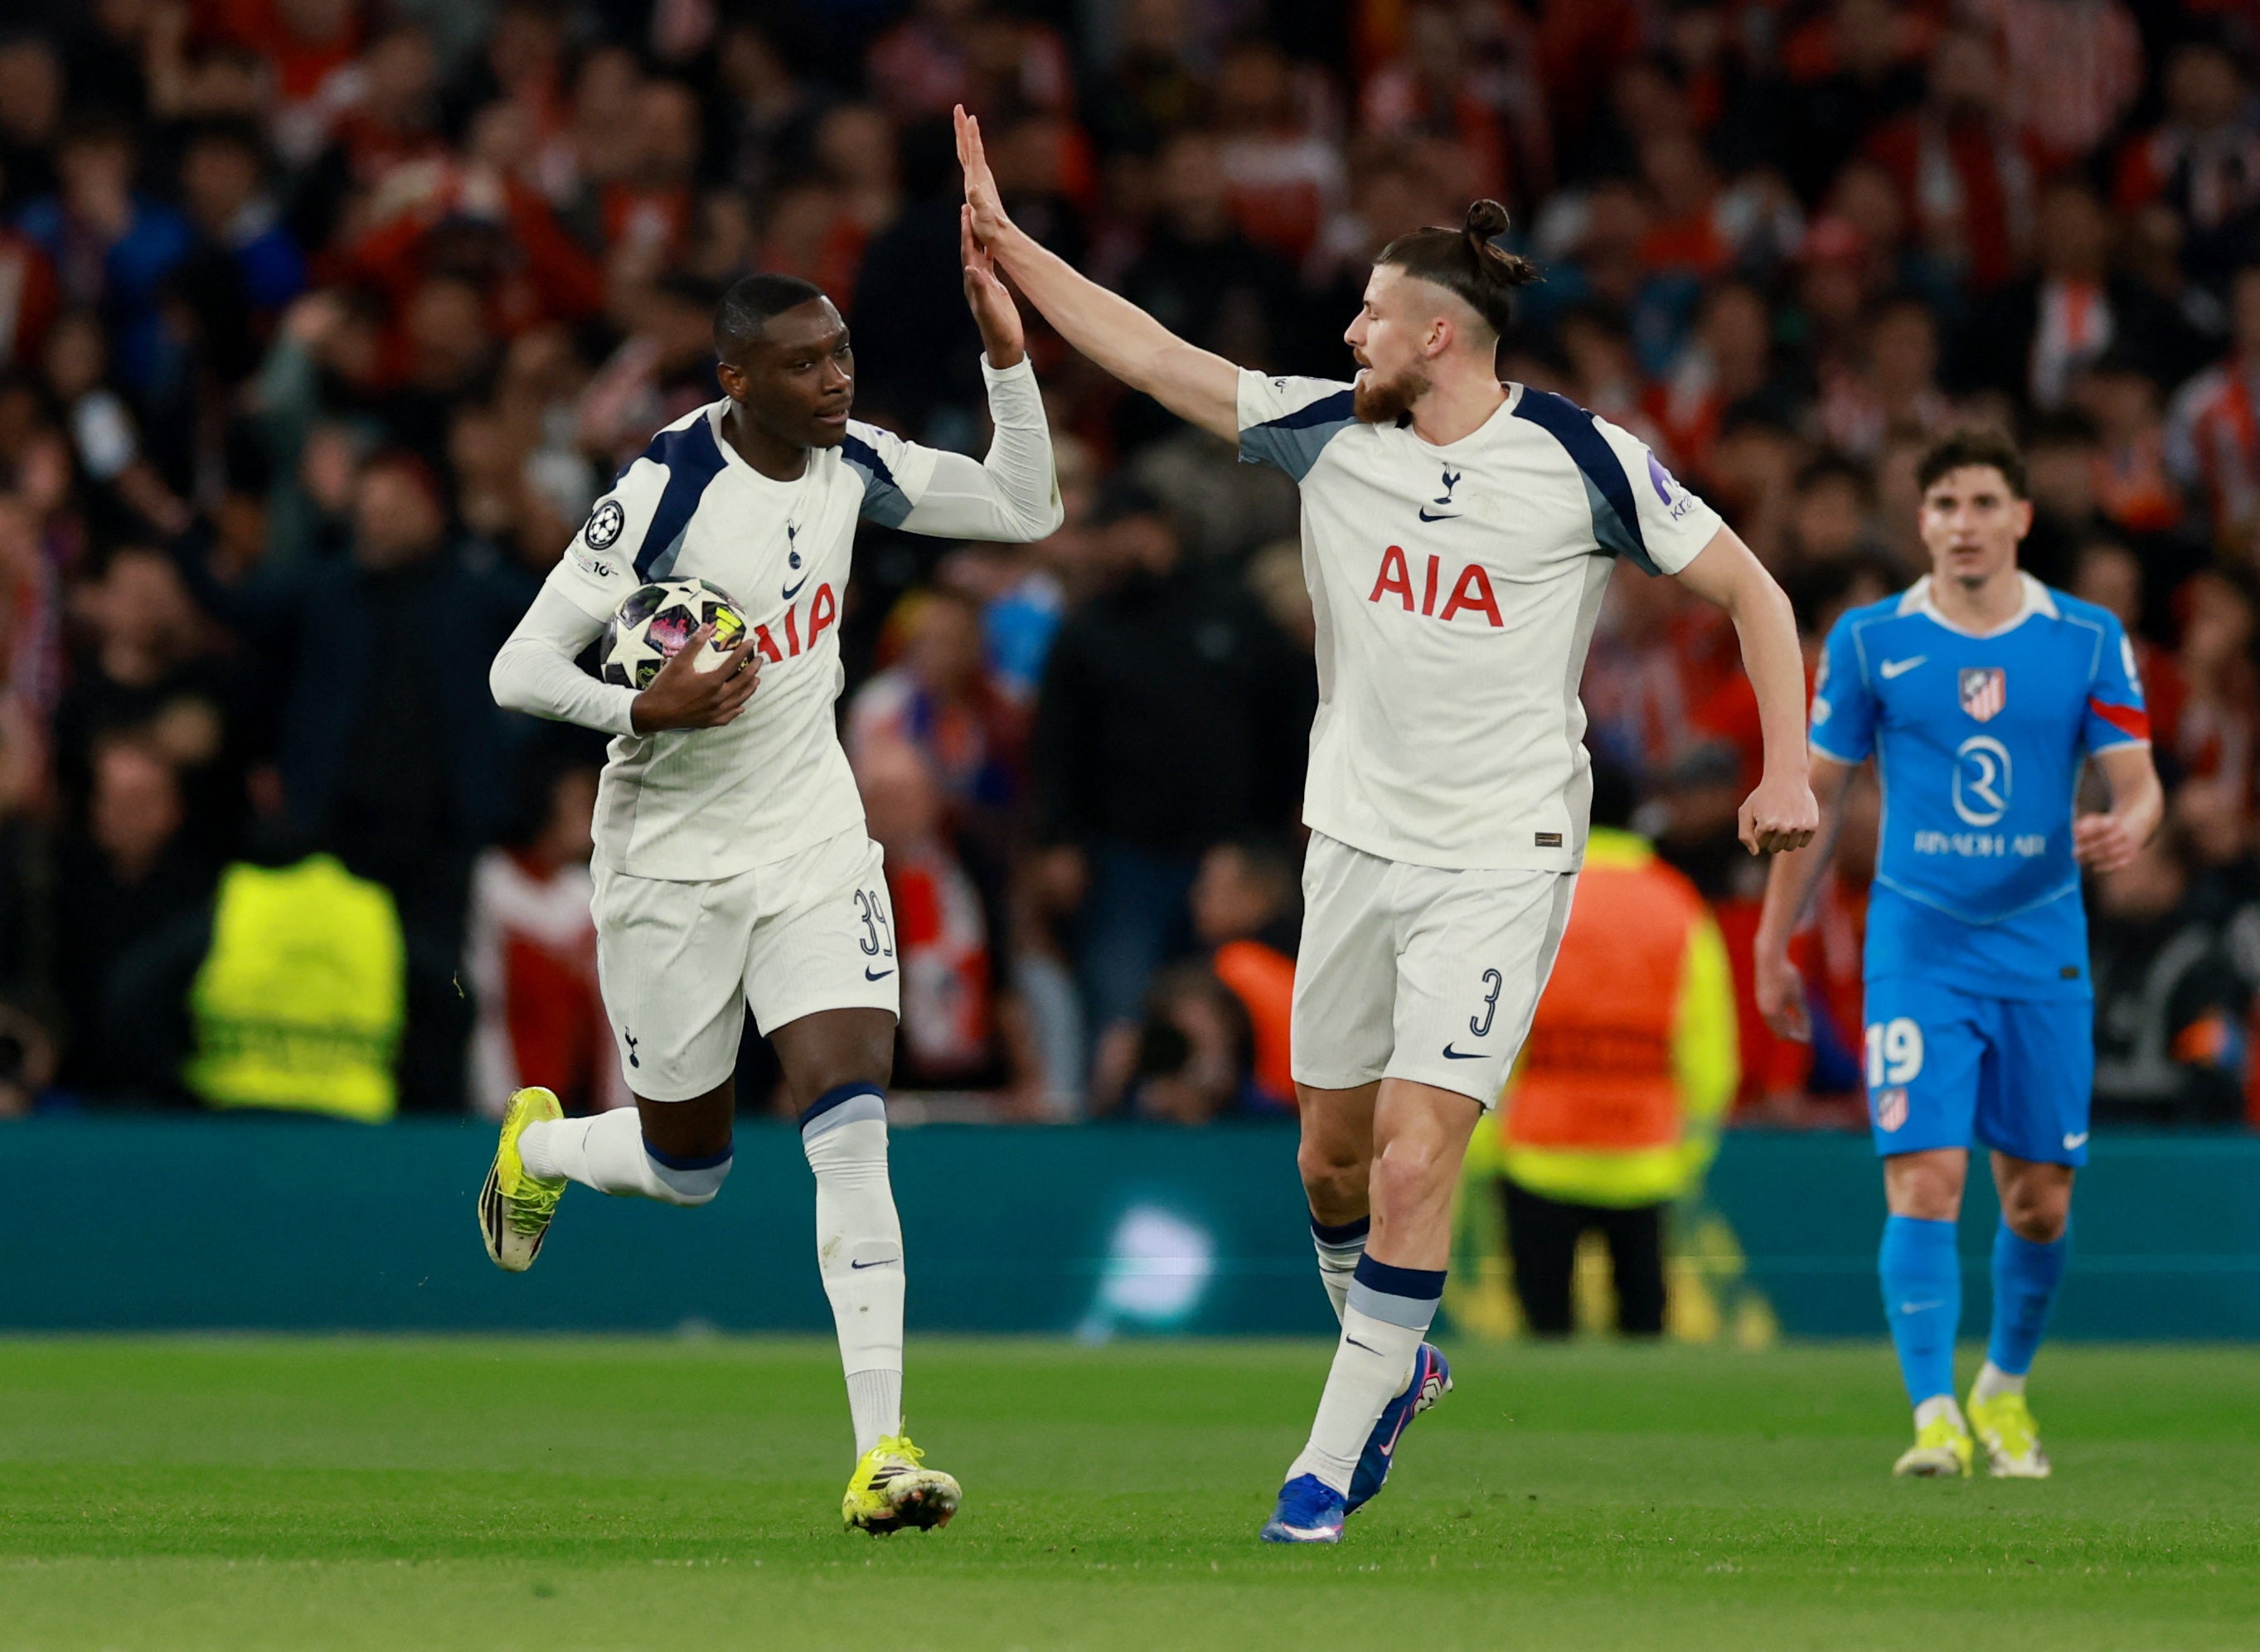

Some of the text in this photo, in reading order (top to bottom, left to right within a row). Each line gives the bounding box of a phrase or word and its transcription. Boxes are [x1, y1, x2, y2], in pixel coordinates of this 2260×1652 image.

[1368, 545, 1505, 627] AIA
[854, 889, 893, 957] 39
[1470, 968, 1502, 1036] 3
[1865, 1016, 1924, 1088] 19
